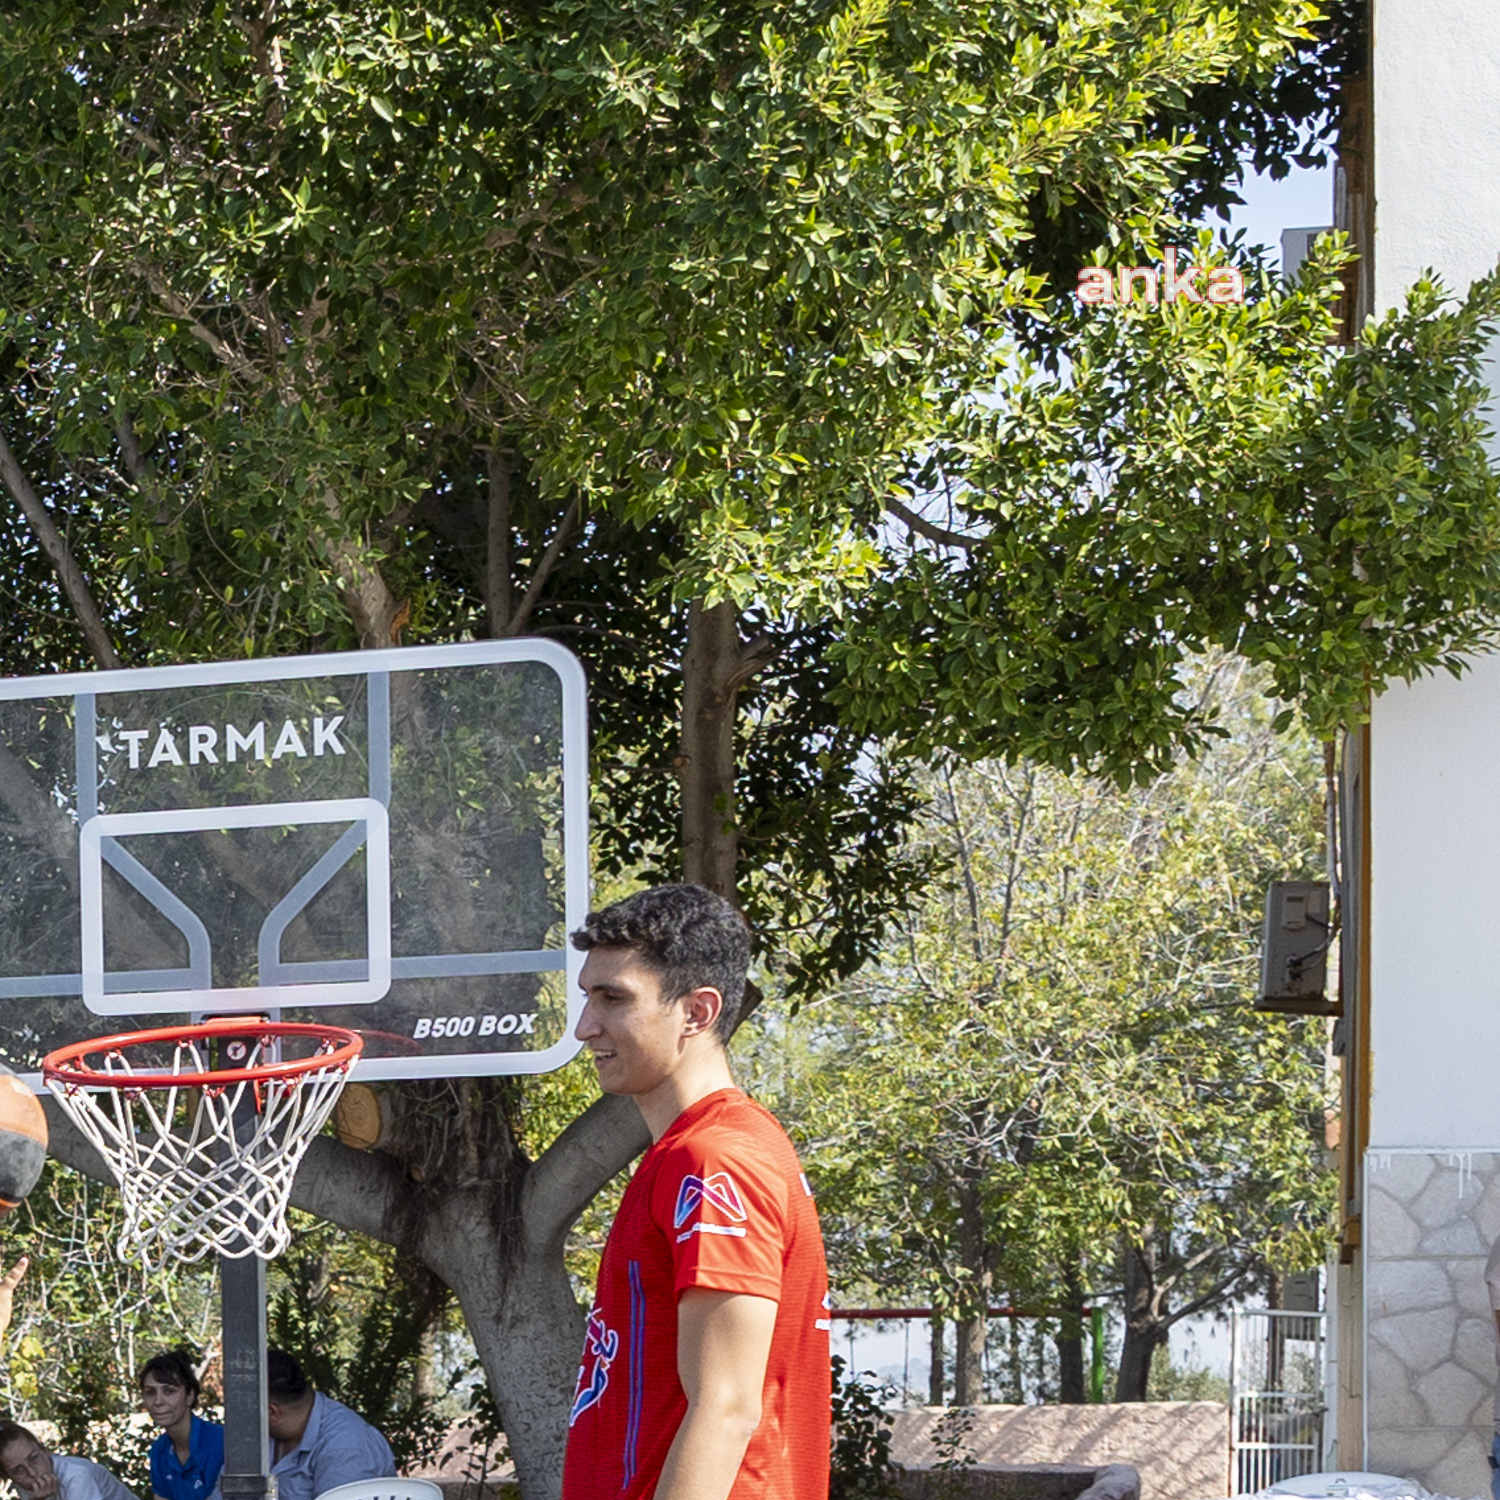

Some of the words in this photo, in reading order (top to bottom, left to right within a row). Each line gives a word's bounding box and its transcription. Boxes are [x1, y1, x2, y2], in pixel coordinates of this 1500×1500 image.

[118, 715, 347, 770] TARMAK
[412, 1016, 476, 1039] B500
[478, 1013, 539, 1036] BOX
